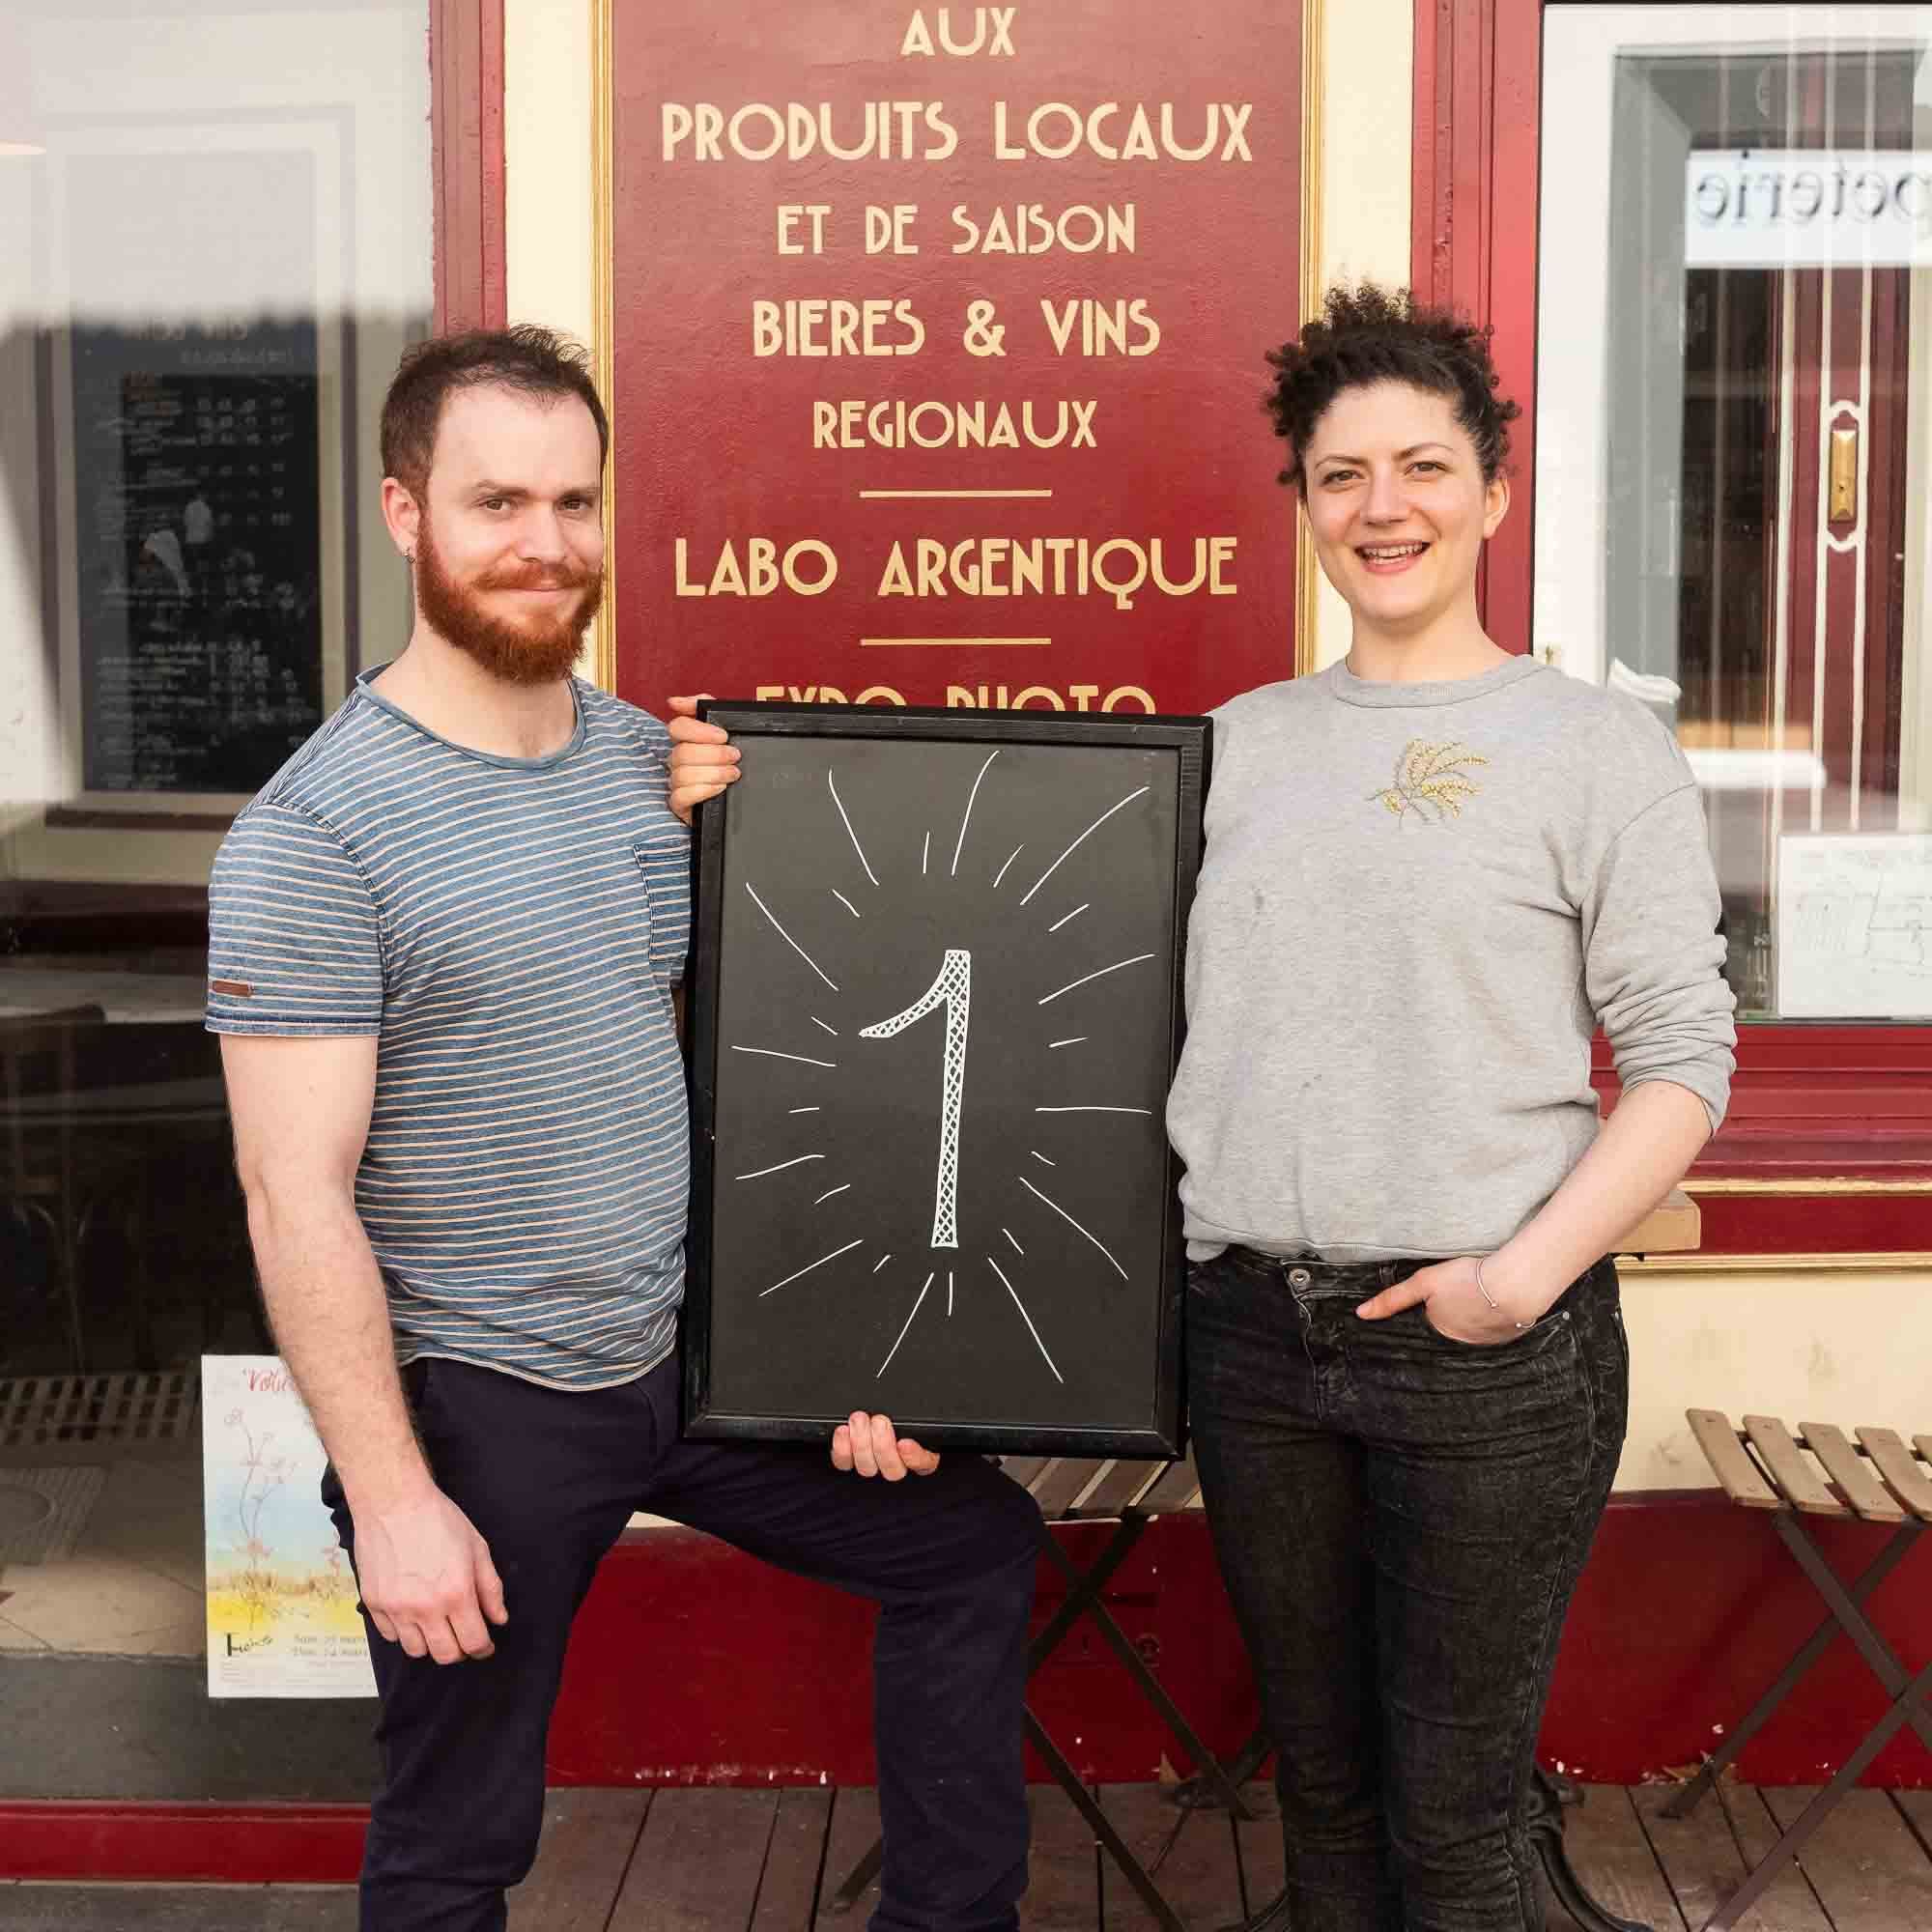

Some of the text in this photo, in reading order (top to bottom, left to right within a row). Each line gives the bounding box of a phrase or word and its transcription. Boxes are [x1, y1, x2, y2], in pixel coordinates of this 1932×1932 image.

[901, 8, 1015, 56] AUX
[662, 101, 1253, 161] PRODUITS LOCAUX
[778, 203, 1135, 255] ET DE SAISON
[753, 298, 1161, 357] BIERES & VINS
[813, 400, 1097, 448] REGIONAUX
[675, 537, 1237, 610] LABO ARGENTIQUE
[859, 949, 971, 1249] 1
